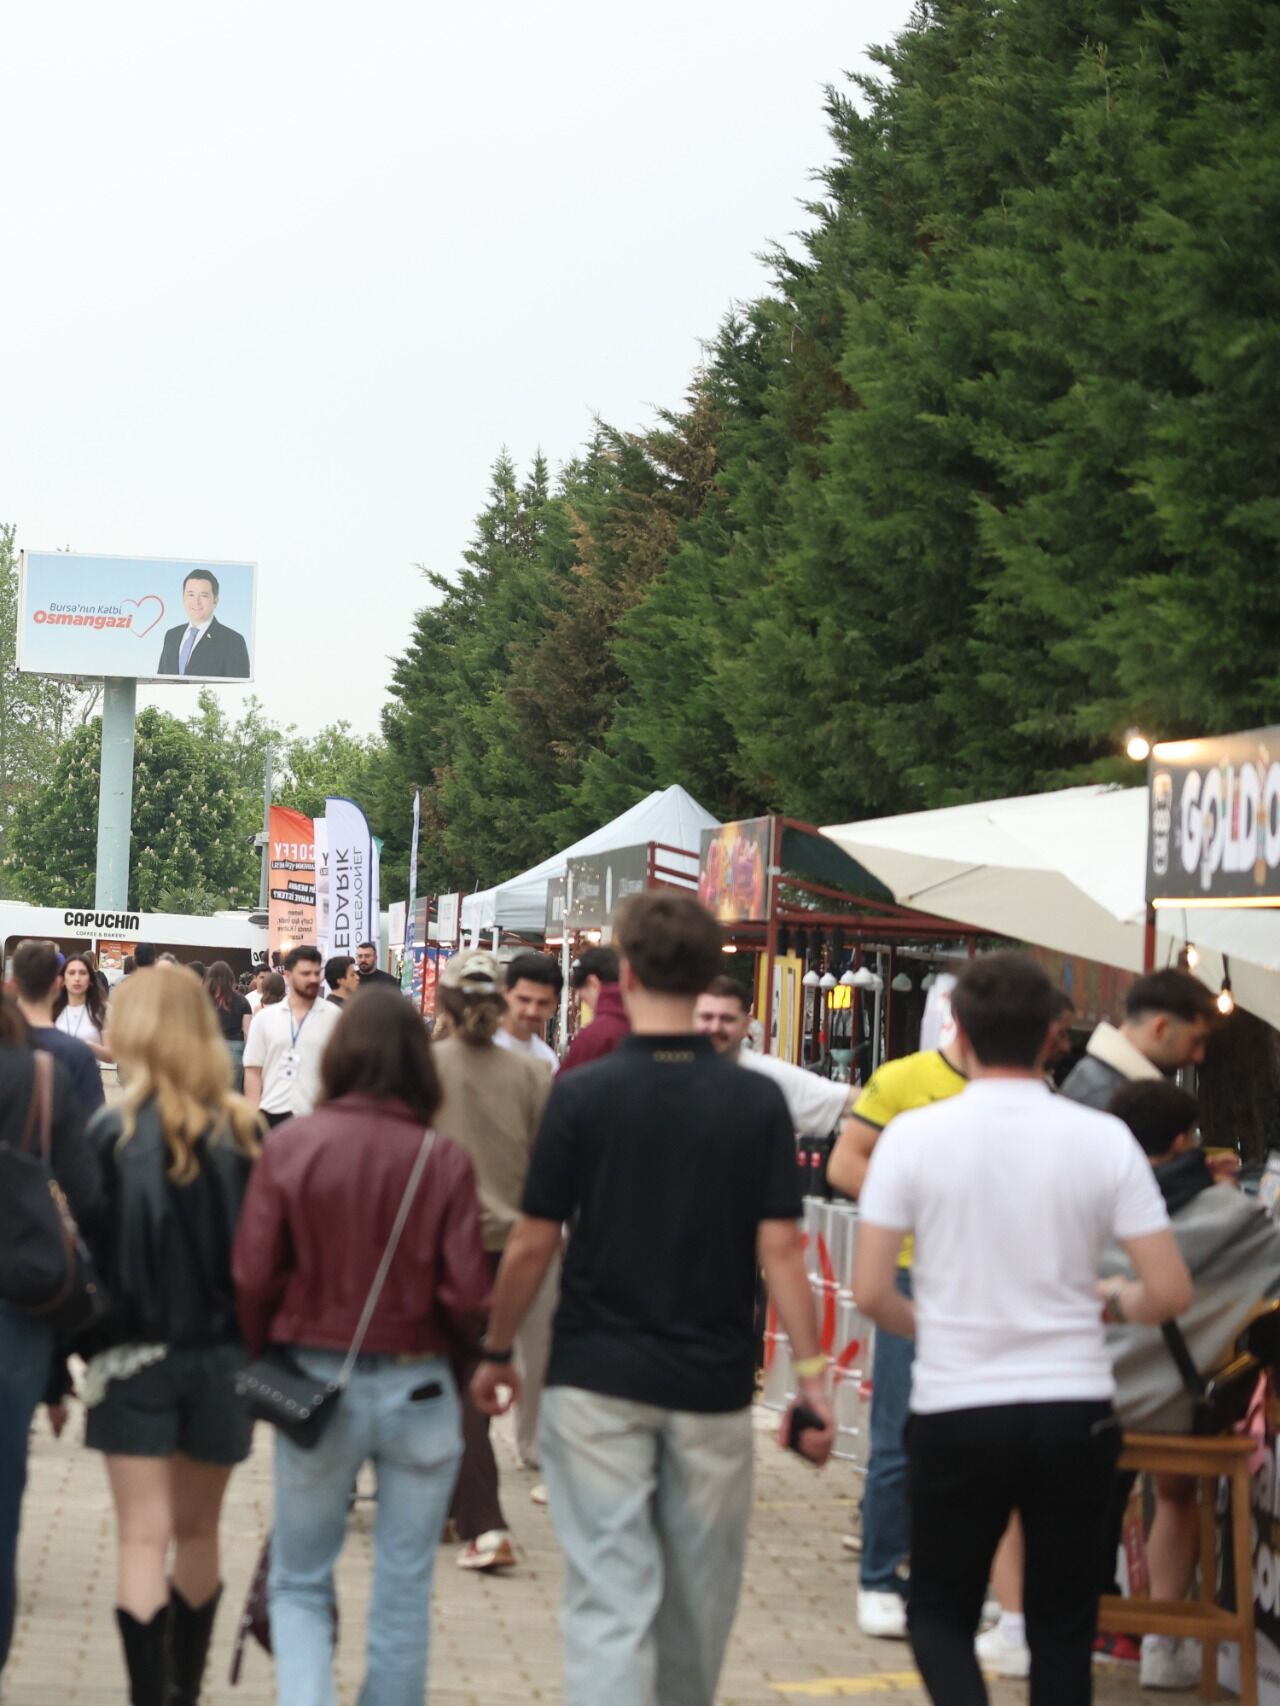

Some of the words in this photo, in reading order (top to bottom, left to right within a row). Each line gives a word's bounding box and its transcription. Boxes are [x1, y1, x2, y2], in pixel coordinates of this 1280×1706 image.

[97, 605, 122, 615] Kalbi
[33, 610, 133, 629] Osmangazi
[64, 912, 140, 930] CAPUCHIN
